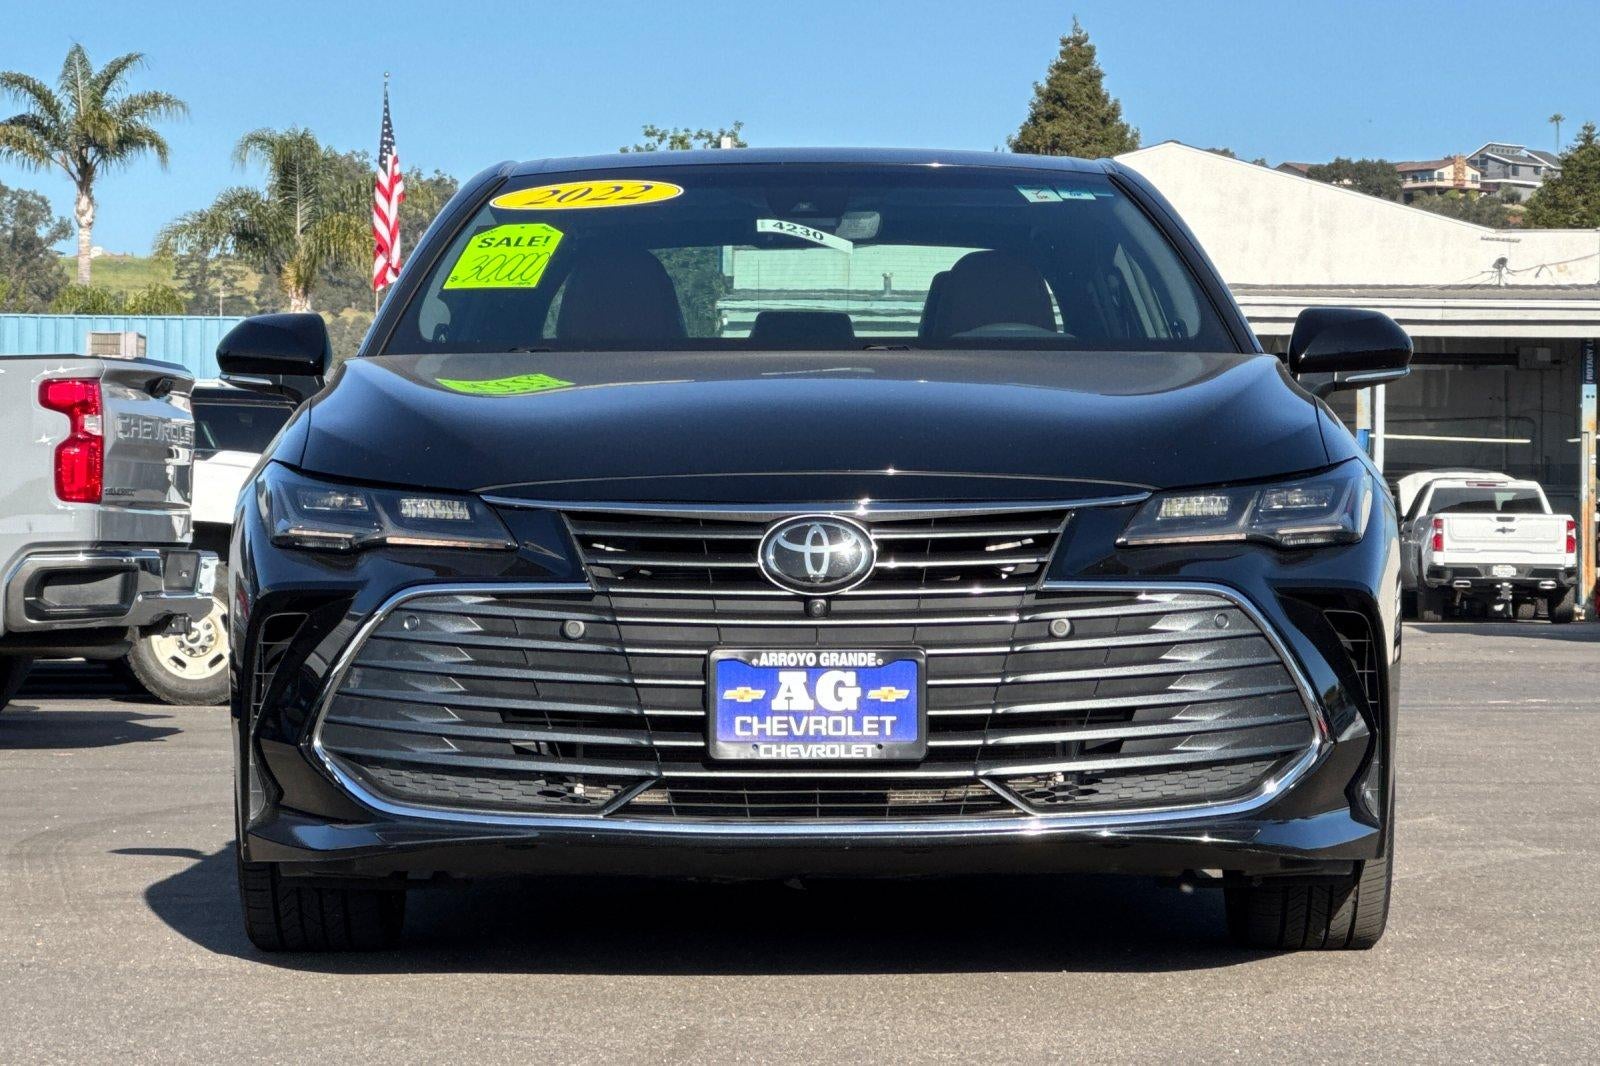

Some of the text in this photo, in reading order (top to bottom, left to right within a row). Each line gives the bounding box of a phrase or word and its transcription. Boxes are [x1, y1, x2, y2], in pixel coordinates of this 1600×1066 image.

[521, 184, 654, 205] 2022
[773, 221, 824, 240] 4230
[478, 236, 551, 249] SALE!
[759, 652, 877, 667] ARROYO GRANDE
[771, 670, 861, 712] AG
[734, 715, 897, 736] CHEVROLET
[759, 743, 877, 759] CHEVROLET
